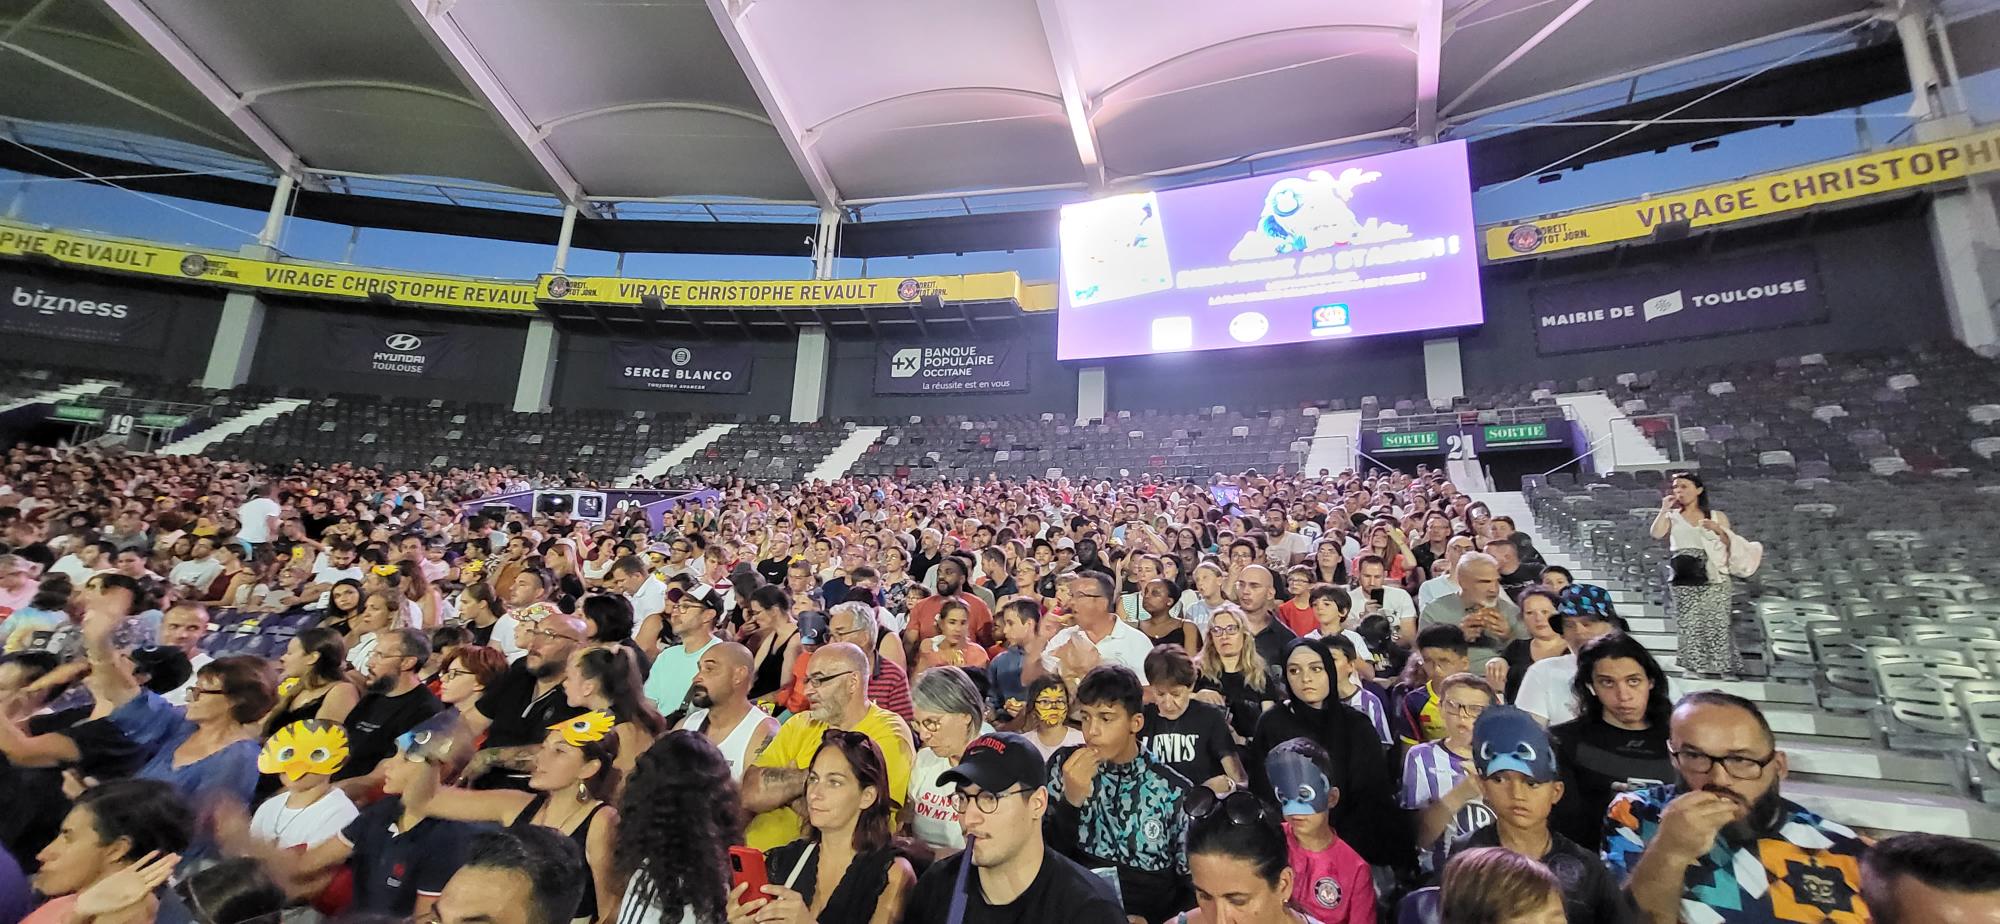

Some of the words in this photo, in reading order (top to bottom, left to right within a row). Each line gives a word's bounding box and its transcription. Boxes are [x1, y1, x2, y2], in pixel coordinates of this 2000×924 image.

[1636, 188, 1758, 227] VIRAGE
[1769, 137, 2000, 204] CHRISTOPH
[0, 231, 47, 252] PHE
[53, 240, 157, 268] REVAULT
[265, 268, 337, 288] VIRAGE
[342, 276, 460, 300] CHRISTOPHE
[463, 287, 537, 305] REVAUL
[619, 283, 682, 300] VIRAGE
[687, 286, 795, 301] CHRISTOPHE
[800, 284, 878, 300] REVAULT
[12, 286, 128, 319] bizness
[1541, 310, 1604, 327] MAIRIE
[1610, 306, 1635, 319] DE
[1692, 279, 1807, 307] TOULOUSE
[373, 352, 425, 363] HYUNDAI
[924, 346, 977, 358] BANQUE
[372, 362, 423, 373] TOULOUSE
[924, 355, 994, 367] POPULAIRE
[624, 367, 670, 378] SERGE
[675, 369, 732, 381] BLANCO
[923, 367, 972, 377] OCCITANE
[922, 382, 930, 390] la
[932, 381, 963, 390] réussite
[108, 414, 134, 434] 19
[1489, 425, 1545, 438] SORTIE
[1385, 433, 1436, 445] SORTIE
[1446, 434, 1477, 459] 21
[917, 802, 932, 817] ON
[932, 809, 949, 821] MY
